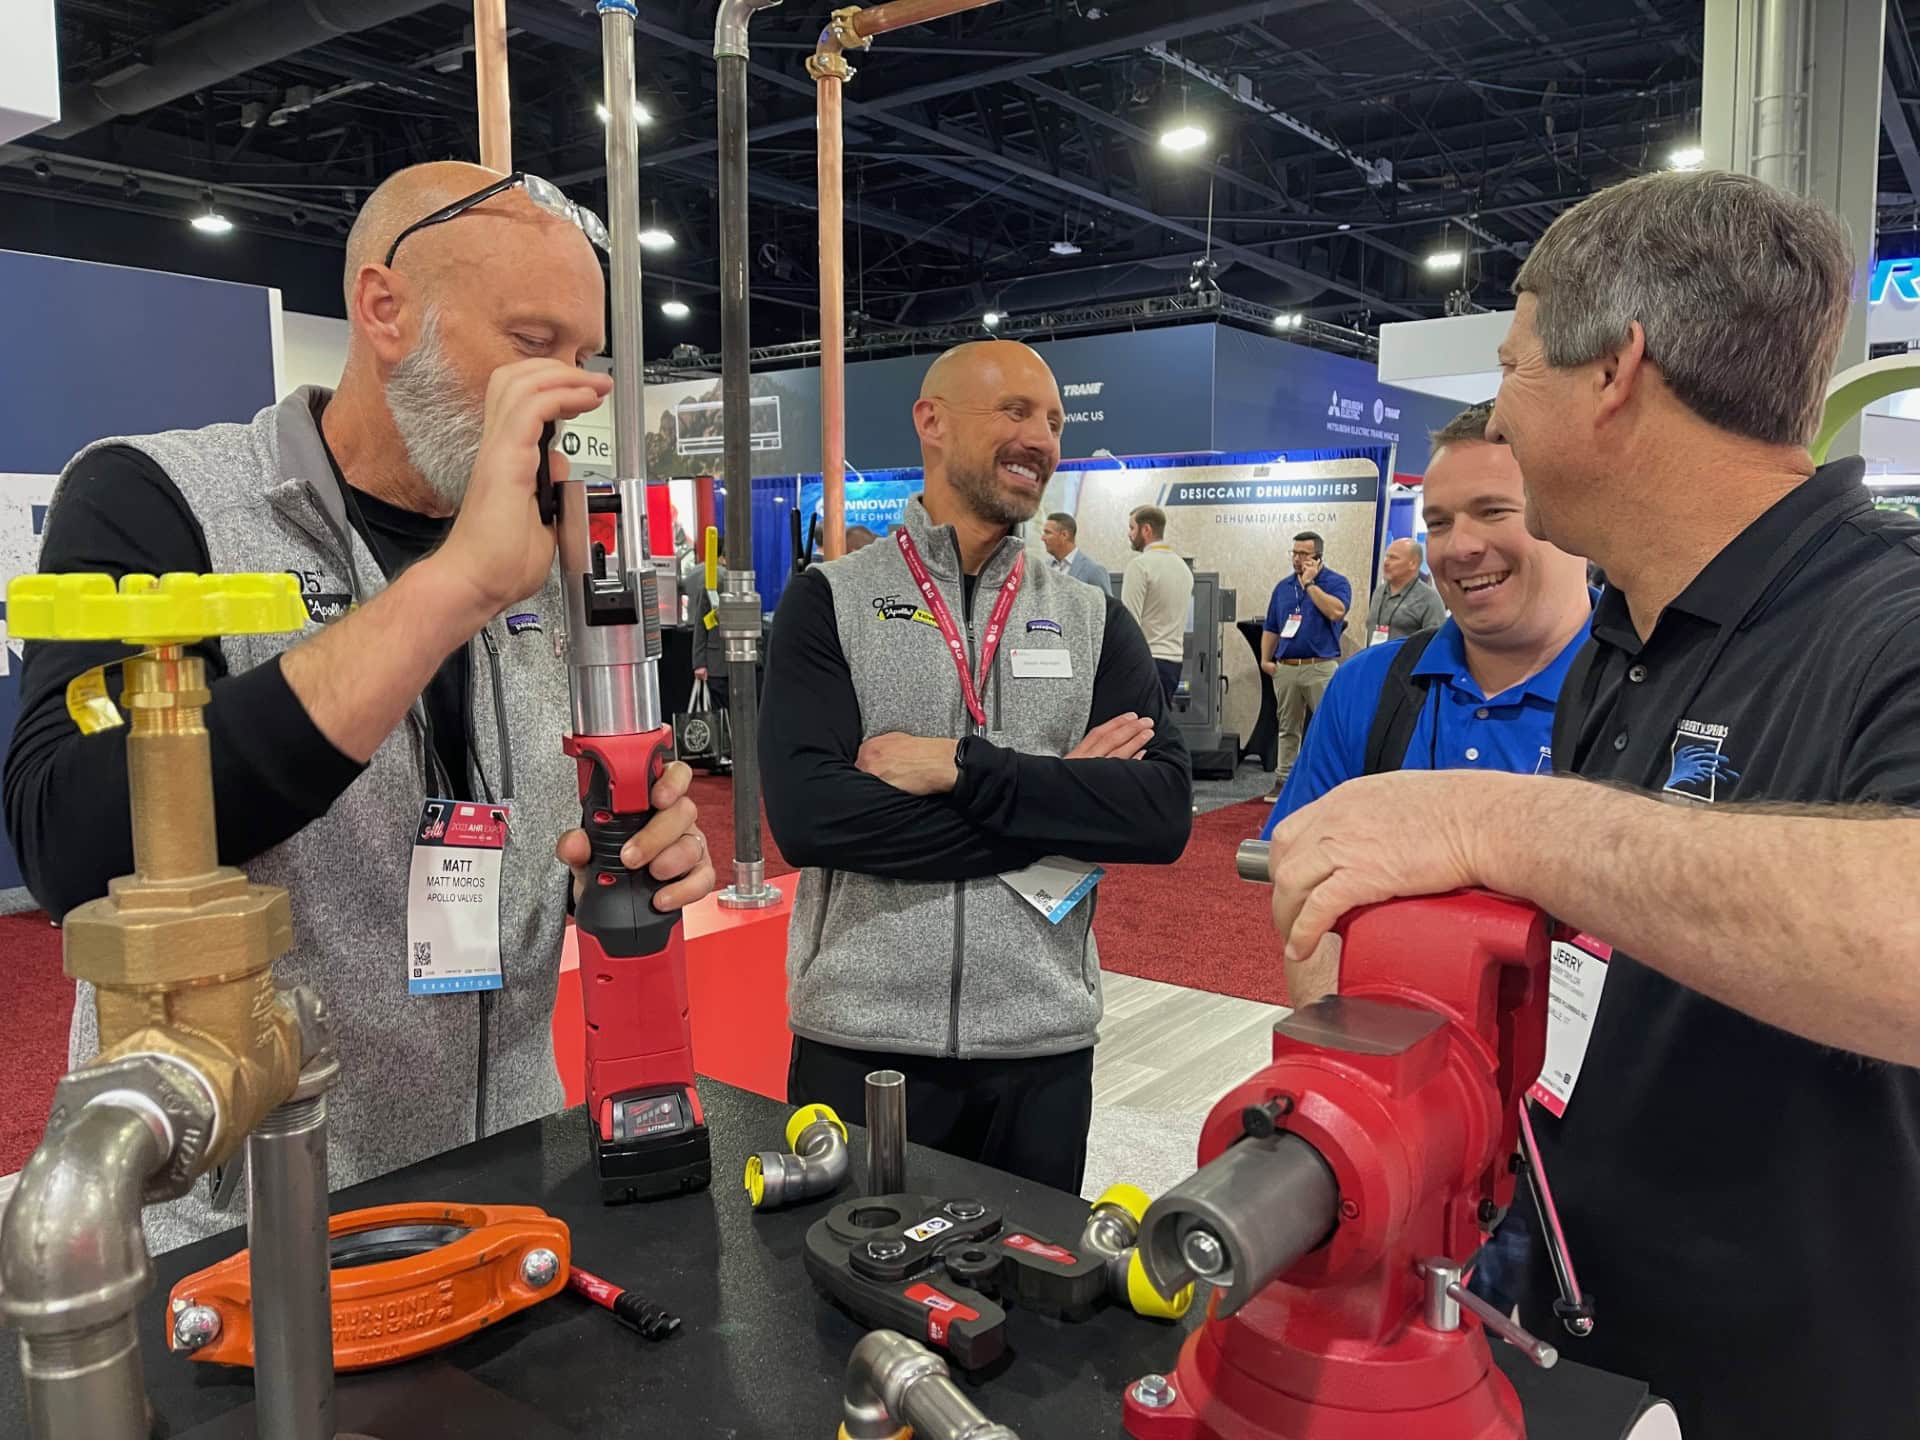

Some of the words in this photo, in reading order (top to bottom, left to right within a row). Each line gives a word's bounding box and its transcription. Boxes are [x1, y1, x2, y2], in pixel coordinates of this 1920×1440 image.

[1063, 382, 1104, 396] TRANE
[1091, 410, 1105, 421] US
[587, 436, 609, 457] Re
[1180, 487, 1251, 499] DESICCANT
[1256, 484, 1358, 498] DEHUMIDIFIERS
[1215, 512, 1337, 524] DEHUMIDIFIERS.COM
[990, 624, 999, 634] LG
[467, 823, 484, 833] AHR
[442, 858, 473, 873] MATT
[426, 876, 451, 887] MATT
[452, 877, 486, 888] MOROS
[427, 893, 456, 903] APOLLO
[457, 894, 483, 903] VALVES
[1552, 947, 1585, 973] JERRY
